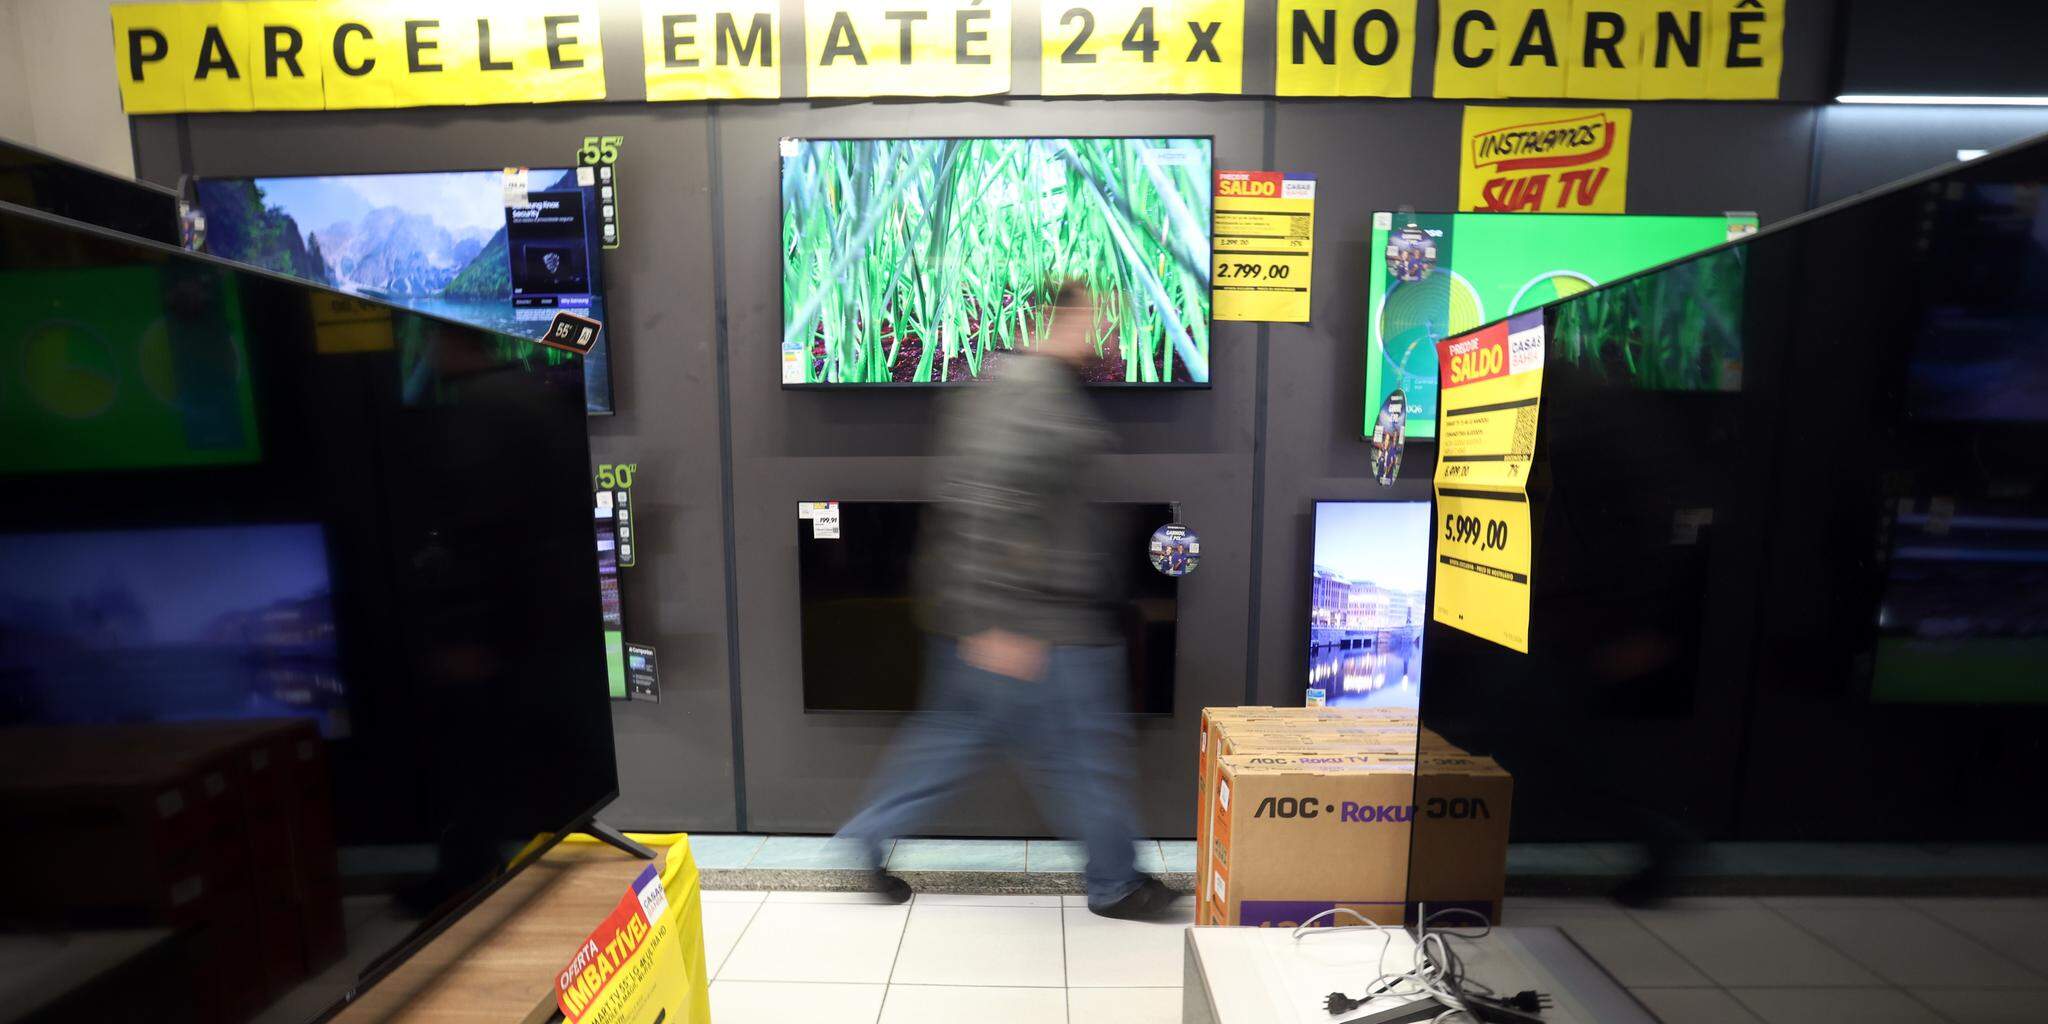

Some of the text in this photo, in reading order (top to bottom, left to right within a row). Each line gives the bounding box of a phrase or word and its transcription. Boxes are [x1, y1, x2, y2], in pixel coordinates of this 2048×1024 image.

[128, 15, 585, 80] PARCELE
[663, 12, 773, 67] EM
[819, 0, 991, 66] ATÉ
[1291, 8, 1399, 67] NO
[1453, 0, 1767, 68] CARNÊ
[584, 136, 624, 165] 55"
[1480, 124, 1603, 158] INSTALAMOS
[1219, 180, 1275, 196] SALDO
[1474, 167, 1609, 213] SUA TV
[1451, 344, 1503, 384] SALDO
[599, 464, 637, 489] 50"
[1445, 513, 1508, 551] 5.999,00
[1254, 797, 1319, 818] AOC
[560, 939, 599, 990] OFERTA
[563, 912, 648, 1017] IMBATÍVEL
